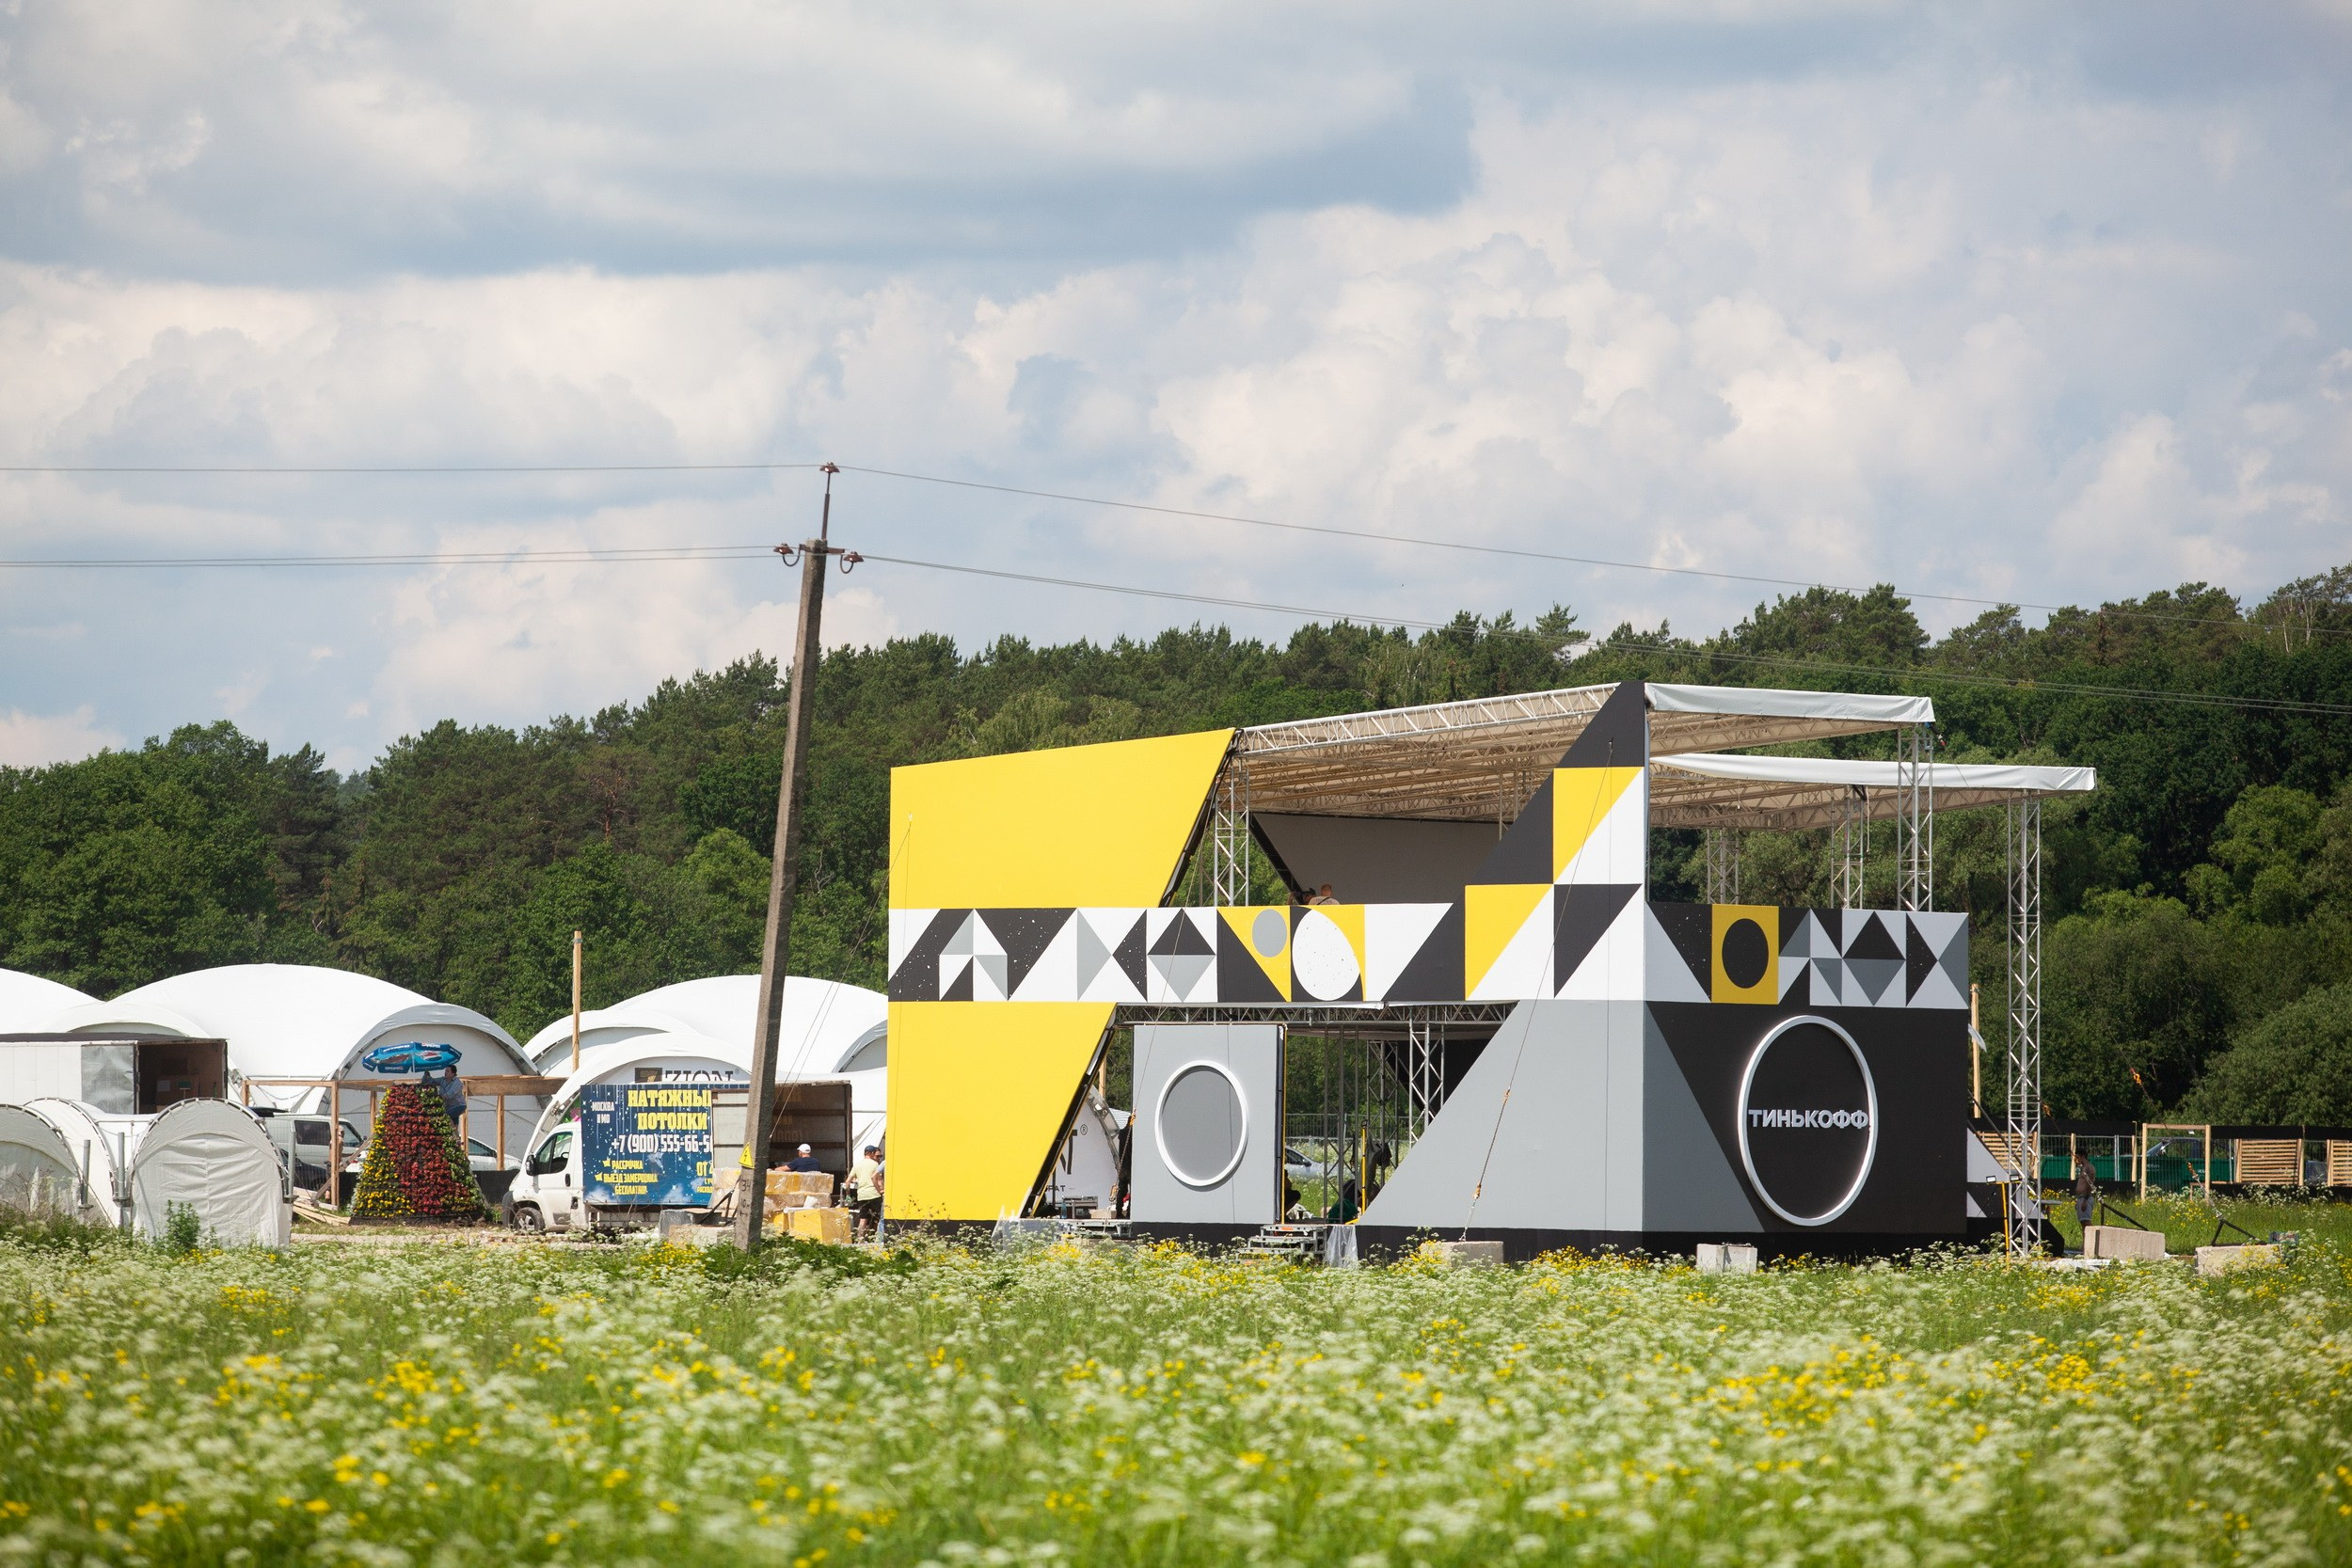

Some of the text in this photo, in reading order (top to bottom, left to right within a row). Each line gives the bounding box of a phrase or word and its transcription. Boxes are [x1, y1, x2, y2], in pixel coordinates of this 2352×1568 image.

[638, 1112, 707, 1130] ПОТОЛКИ
[1748, 1109, 1869, 1129] ТИНЬКОФФ
[612, 1133, 712, 1153] +7 (900) 555-66-5
